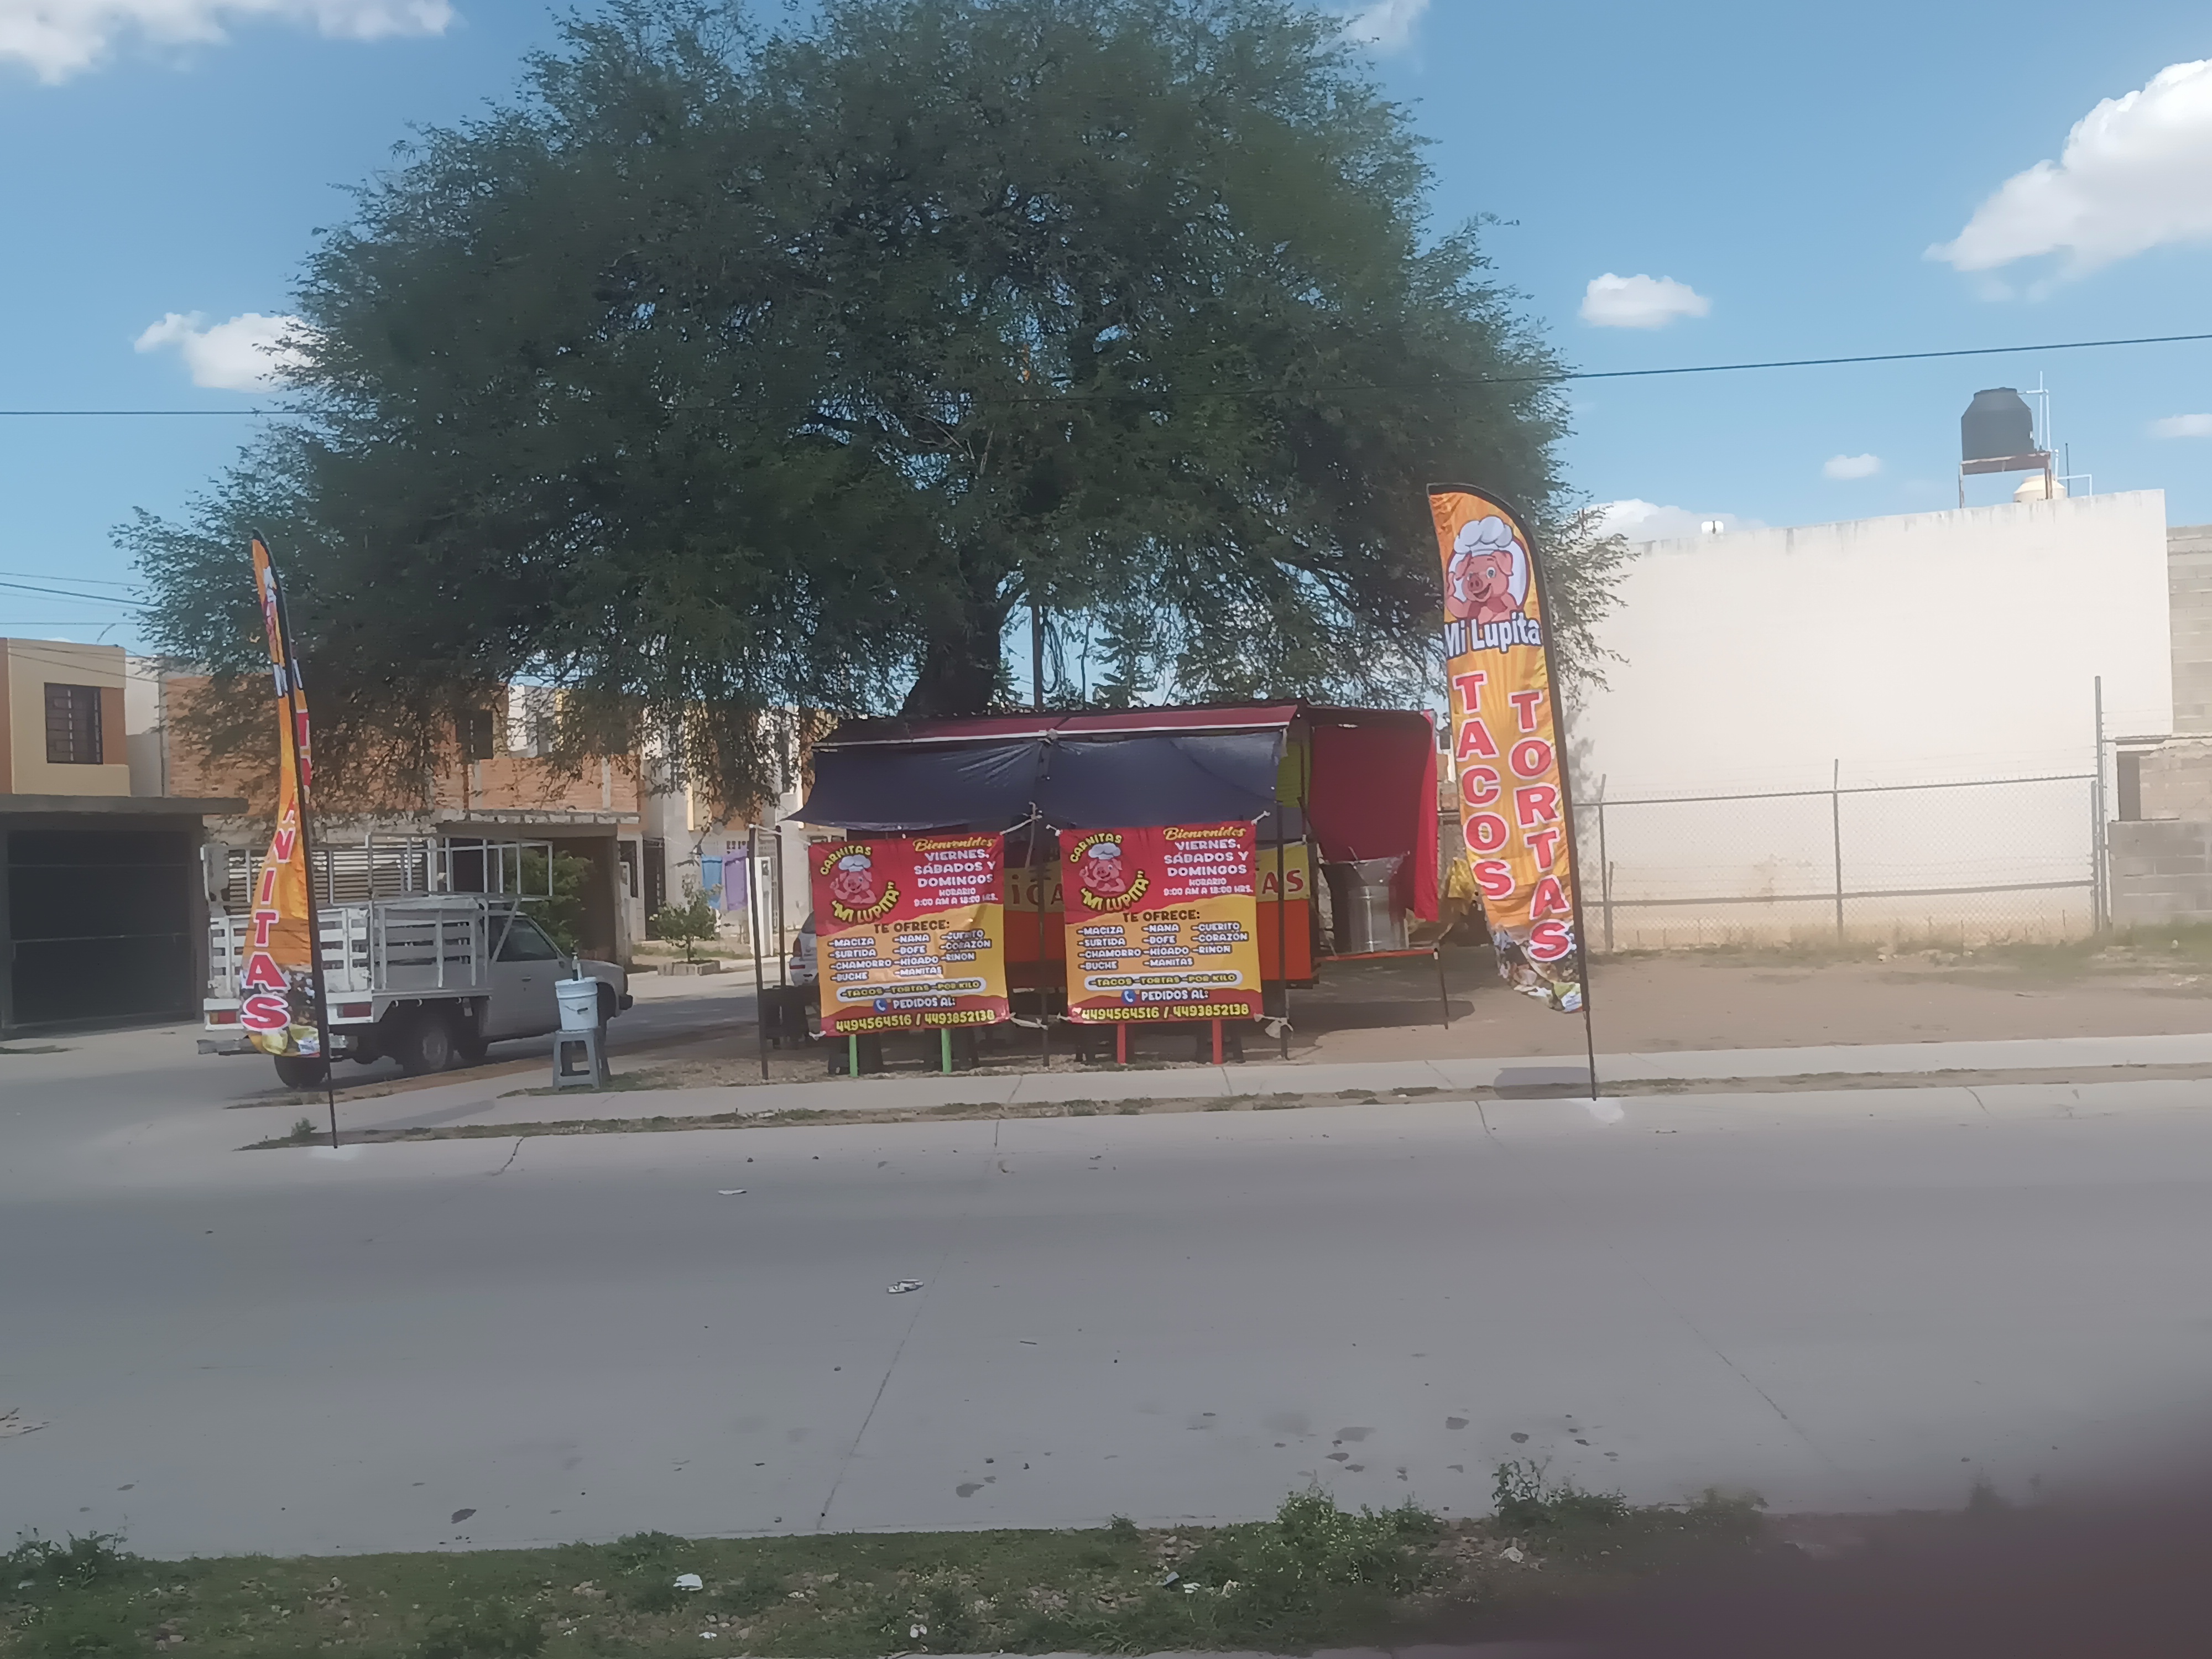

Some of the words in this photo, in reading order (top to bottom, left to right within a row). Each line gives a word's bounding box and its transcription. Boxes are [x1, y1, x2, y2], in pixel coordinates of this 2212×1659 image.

[1471, 612, 1541, 652] Lupita
[1453, 670, 1515, 900] TACOS
[1508, 690, 1572, 961] TORTAS
[1070, 833, 1122, 862] CARNITAS
[820, 846, 872, 875] CARNITAS
[1238, 851, 1249, 861] Y
[987, 861, 995, 870] Y
[1167, 864, 1247, 877] DOMINGOS
[918, 874, 993, 888] DOMINGOS
[1189, 878, 1227, 886] HORARIO
[939, 888, 975, 896] HORARIO
[1185, 887, 1199, 895] AM
[1123, 912, 1139, 922] TE
[1142, 910, 1200, 921] OFRECE:
[874, 924, 889, 933] TE
[894, 920, 950, 932] OFRECE:
[1141, 990, 1188, 1001] PEDIDOS
[893, 998, 937, 1009] PEDIDOS
[1082, 1007, 1160, 1020] 4494564516
[1173, 1004, 1249, 1017] 4493852138
[836, 1014, 911, 1032] 4494564516
